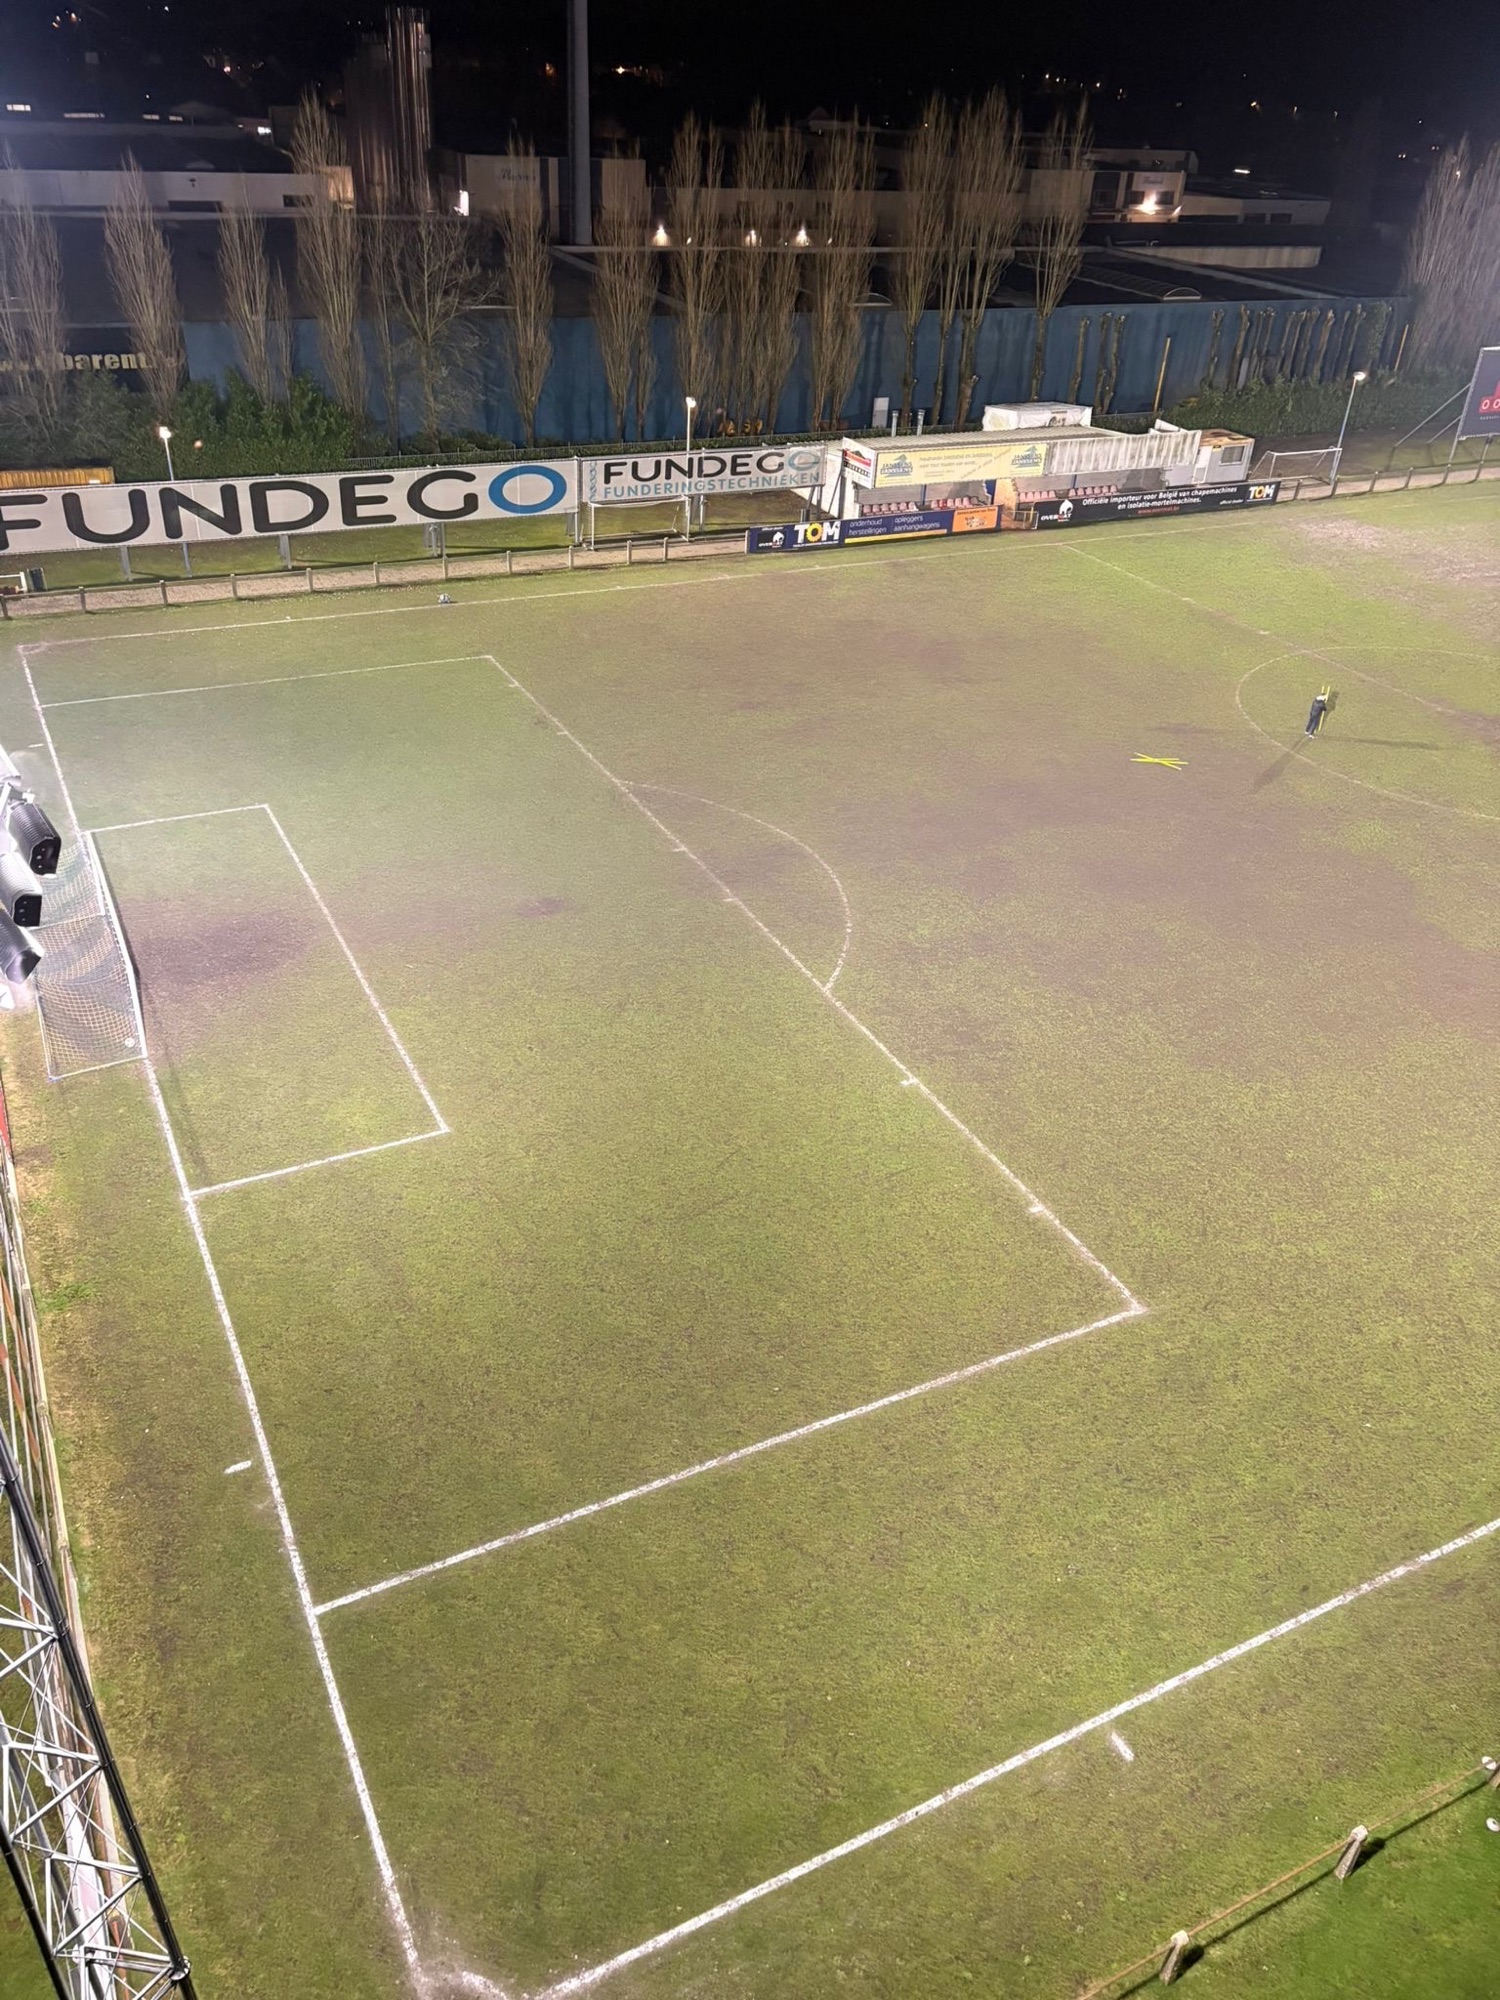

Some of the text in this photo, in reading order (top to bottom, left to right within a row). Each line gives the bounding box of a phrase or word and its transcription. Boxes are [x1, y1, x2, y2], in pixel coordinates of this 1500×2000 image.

[603, 450, 821, 485] FUNDEGO
[603, 471, 821, 499] FUNDERINGSTECHNIEKEN
[1248, 484, 1276, 499] TOM
[1082, 486, 1238, 506] Officiële importeur voor België van chapemachines
[0, 464, 567, 550] FUNDEGO
[849, 517, 883, 528] onderhoud
[893, 521, 941, 533] aanhangwagens
[894, 514, 924, 525] opleggers
[793, 520, 842, 544] TOM
[848, 526, 888, 536] herstellingen
